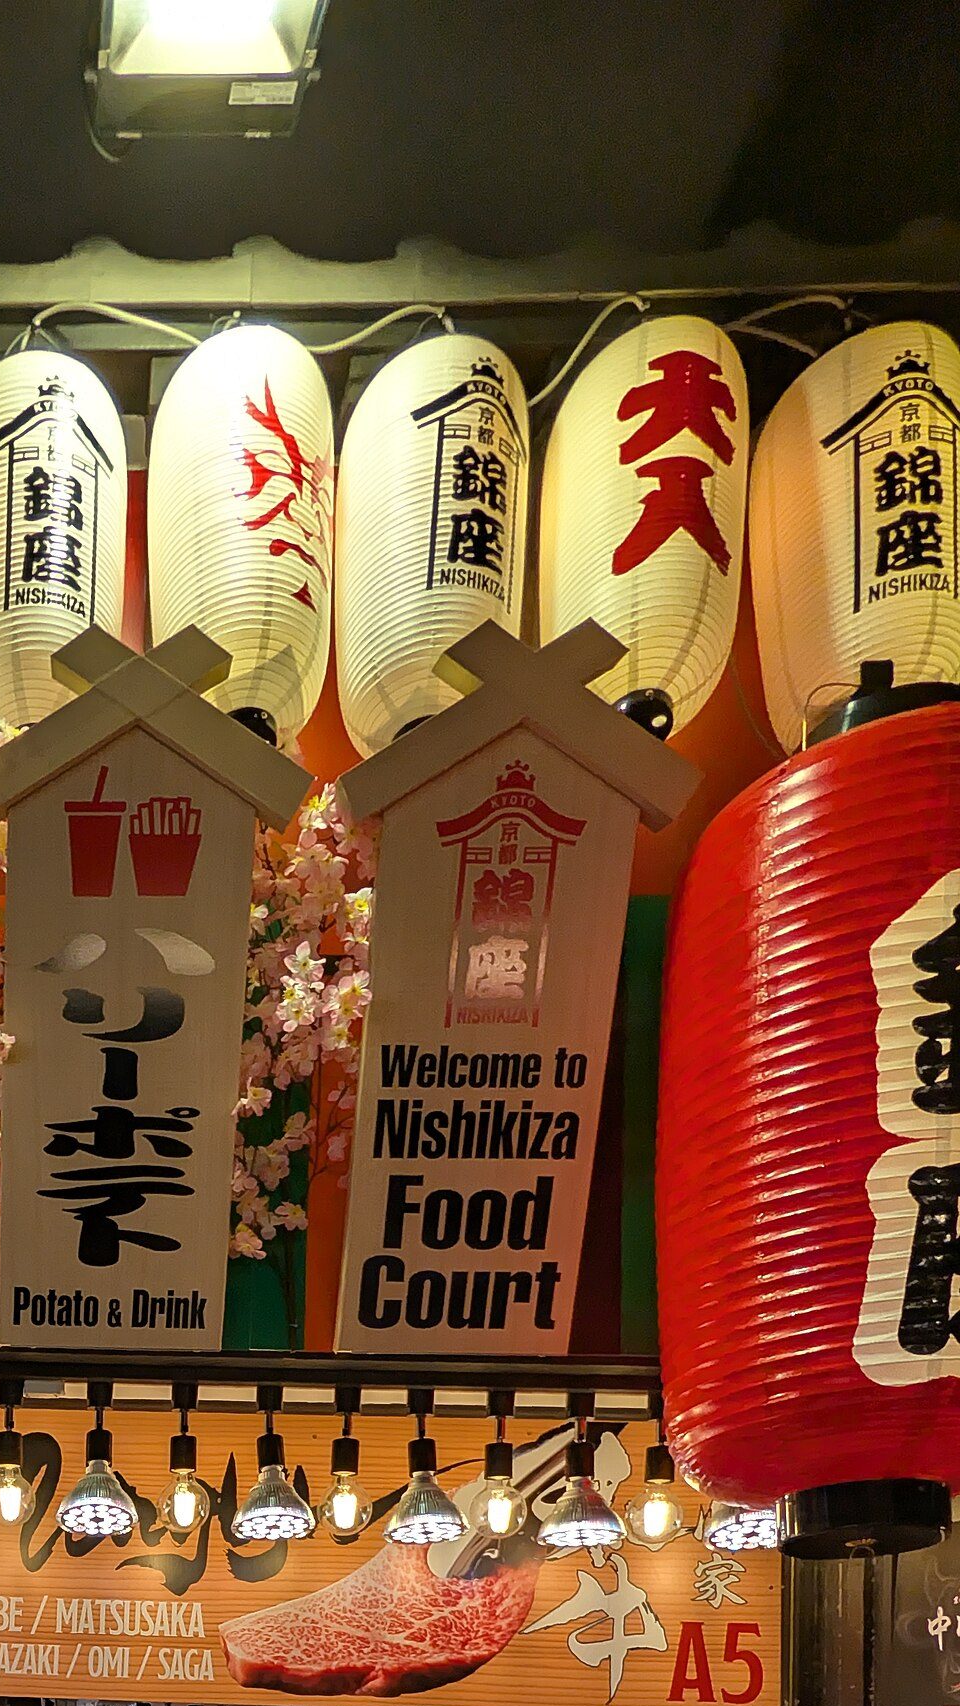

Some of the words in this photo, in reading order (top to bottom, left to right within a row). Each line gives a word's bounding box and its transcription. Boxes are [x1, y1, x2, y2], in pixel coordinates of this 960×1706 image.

[466, 383, 508, 406] KYOTO
[883, 378, 934, 398] KYOTO
[476, 406, 496, 445] 京都
[898, 402, 922, 444] 京都
[446, 444, 507, 575] 錦座
[874, 445, 944, 577] 錦座
[15, 587, 86, 619] NISKIZA
[867, 574, 951, 604] NISHIKIZA
[490, 793, 537, 810] KYOTO
[498, 821, 521, 865] 京都
[464, 867, 535, 1000] 錦座
[380, 1043, 542, 1089] Welcome
[553, 1046, 588, 1089] to
[372, 1098, 581, 1161] Nishikiza
[382, 1174, 554, 1252] Food
[12, 1285, 99, 1328] Potato
[106, 1301, 122, 1325] &
[131, 1287, 208, 1330] Drink
[357, 1253, 562, 1332] Court
[29, 1594, 49, 1636] /
[55, 1597, 206, 1639] MATSUSAKA
[66, 1642, 83, 1679] /
[87, 1645, 131, 1680] OMI
[136, 1644, 153, 1681] /
[157, 1647, 216, 1682] SAGA
[666, 1620, 764, 1705] A5
